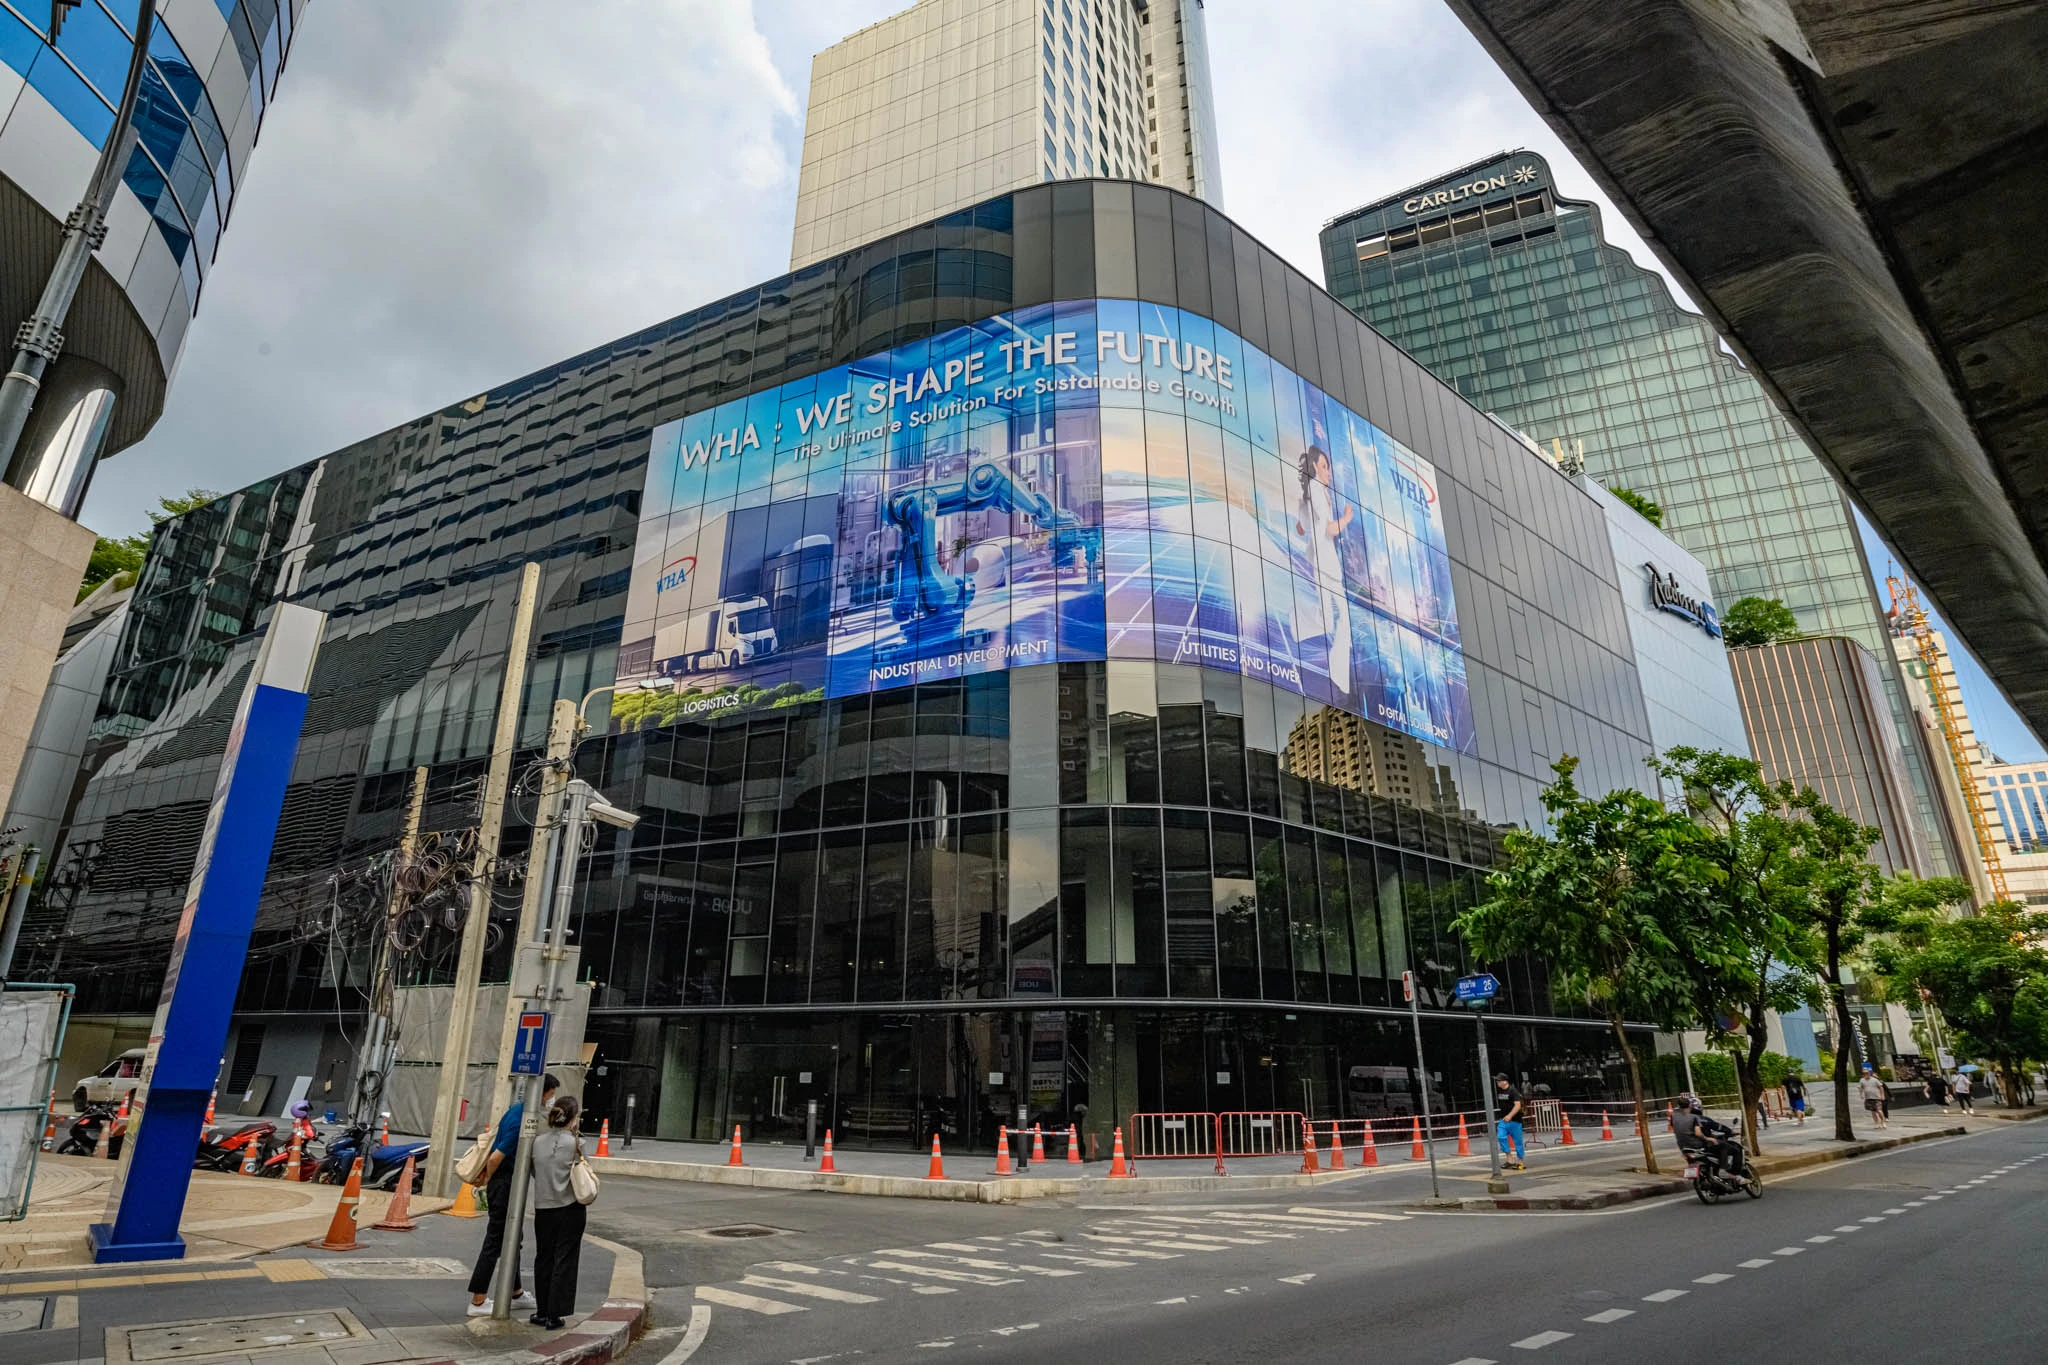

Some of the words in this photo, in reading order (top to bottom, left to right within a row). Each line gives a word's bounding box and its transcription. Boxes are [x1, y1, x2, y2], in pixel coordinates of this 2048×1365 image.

[1403, 174, 1506, 214] CARLTON
[681, 423, 760, 471] WHA
[796, 391, 855, 435] WE
[866, 350, 985, 414] SHAPE
[999, 331, 1077, 373] THE
[1097, 329, 1235, 390] FUTURE
[793, 442, 821, 462] The
[828, 419, 902, 451] Ultimate
[909, 396, 987, 428] Solution
[993, 384, 1026, 404] For
[1034, 372, 1161, 394] Sustainable
[1168, 379, 1237, 417] Growth
[1390, 468, 1430, 511] WHA
[656, 568, 686, 594] WHA
[869, 659, 943, 681] INDUSTRIAL
[948, 640, 1049, 667] DEVELOPMENT
[1182, 642, 1237, 662] UTILITIES
[1240, 654, 1264, 671] AND
[683, 694, 740, 714] LOGISTICS
[1378, 704, 1408, 725] DGITAL
[1483, 980, 1493, 991] 25
